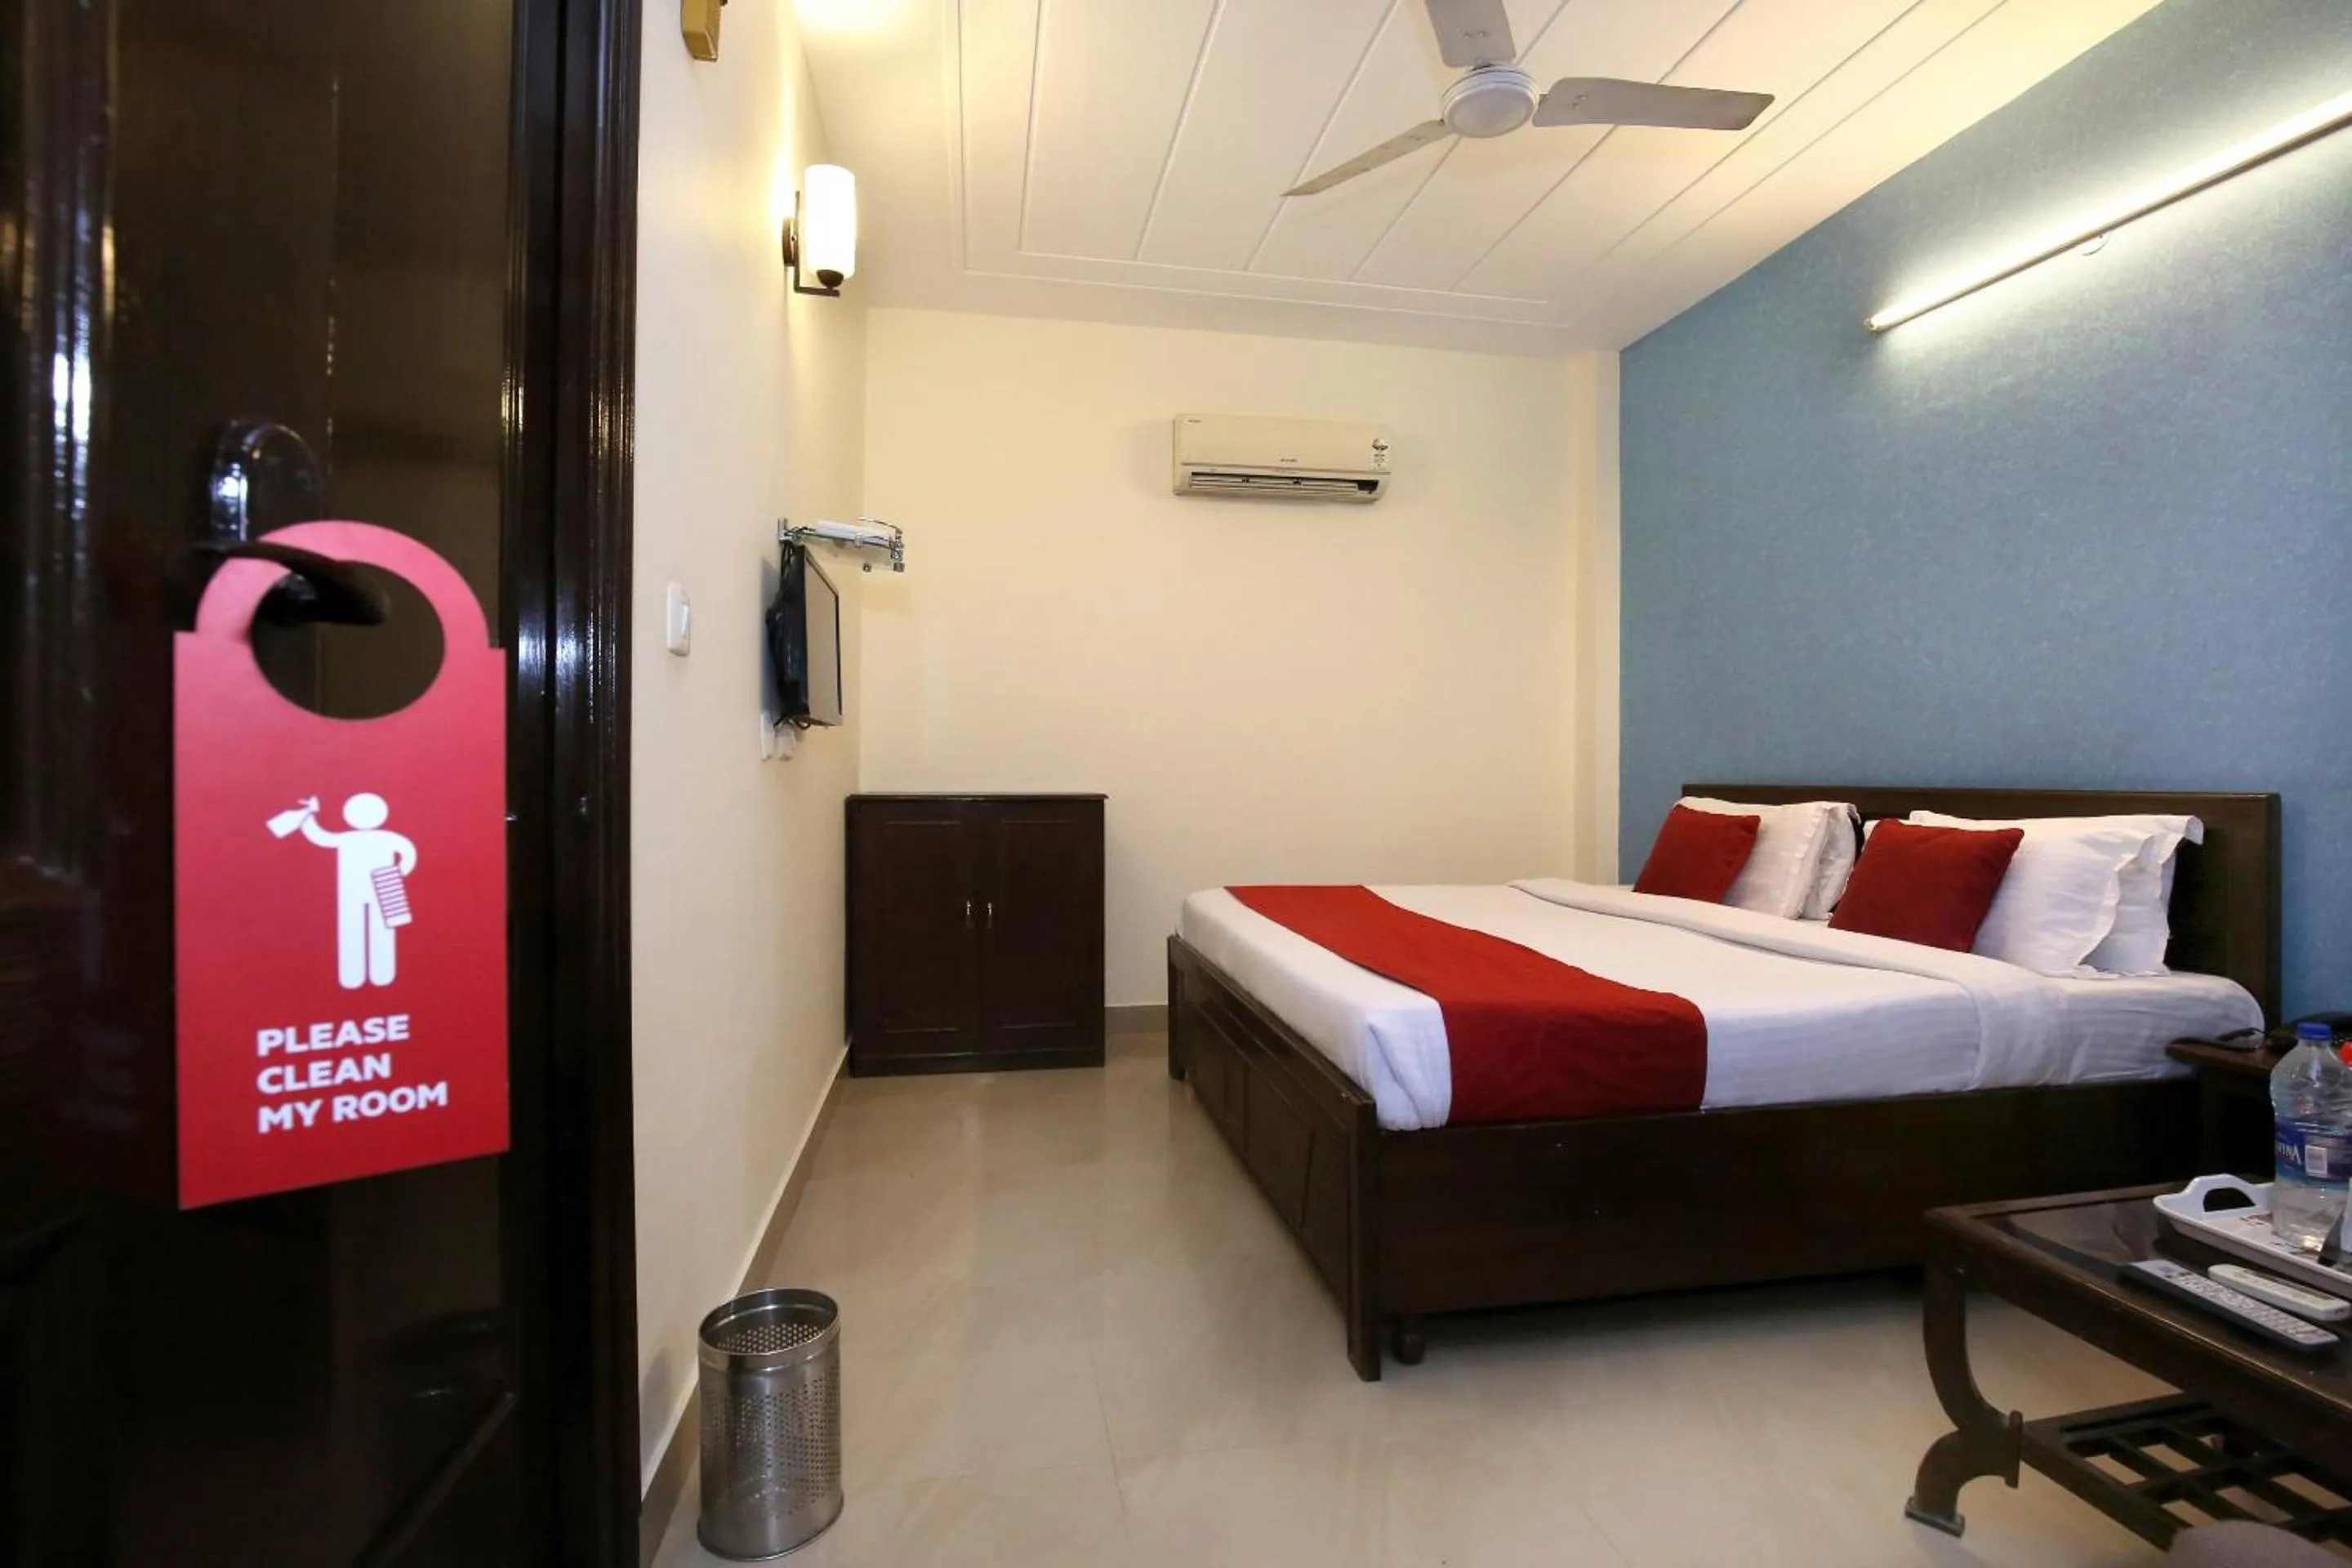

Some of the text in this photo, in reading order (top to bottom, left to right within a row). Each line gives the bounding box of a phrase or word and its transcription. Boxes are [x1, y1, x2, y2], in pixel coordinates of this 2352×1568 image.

[256, 1013, 409, 1057] PLEASE
[256, 1053, 391, 1094] CLEAN
[258, 1081, 448, 1134] MY ROOM
